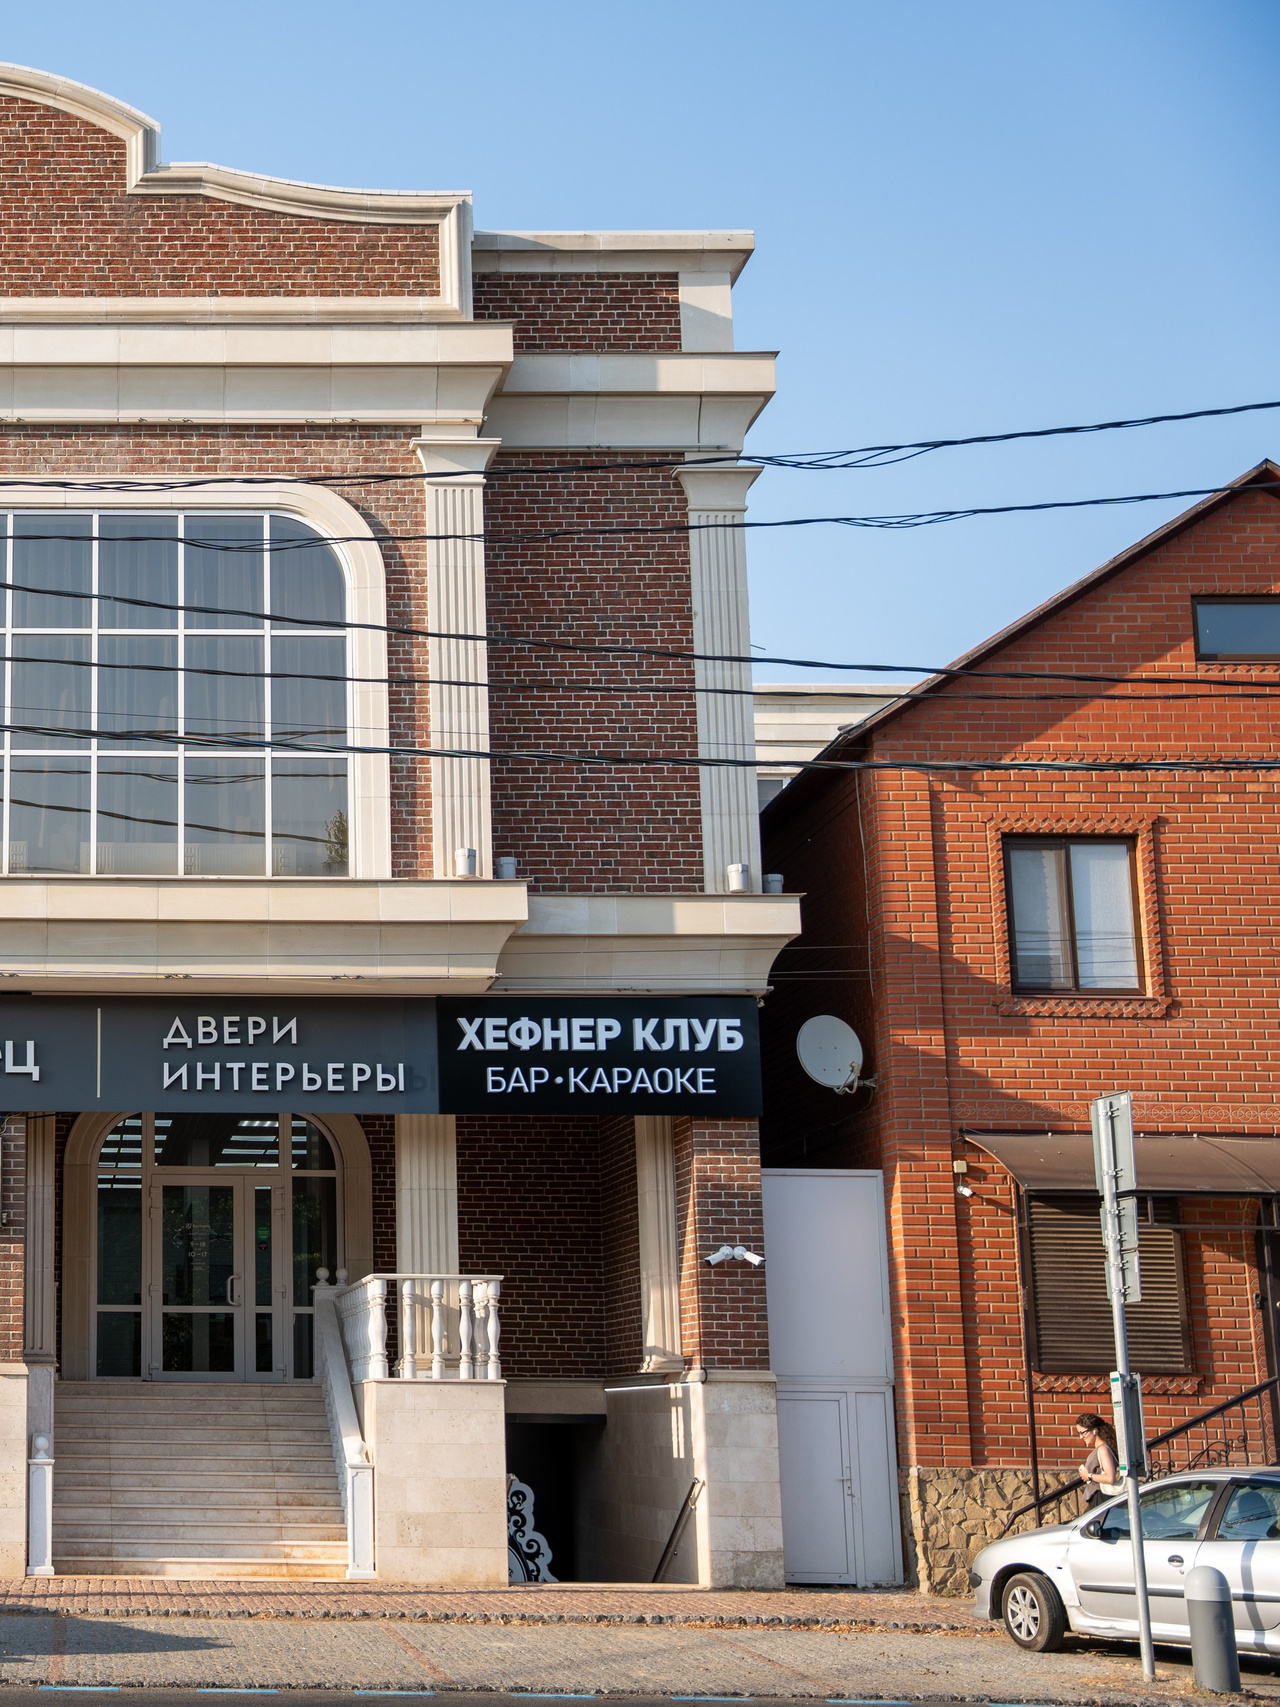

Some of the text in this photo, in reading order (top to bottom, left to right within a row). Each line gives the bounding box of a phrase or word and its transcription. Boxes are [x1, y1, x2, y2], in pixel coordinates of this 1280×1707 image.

[164, 1017, 296, 1048] ДВЕРИ
[457, 1017, 743, 1051] ХЕФНЕР КЛУБ
[164, 1063, 404, 1091] ИНТЕРЬЕРЫ
